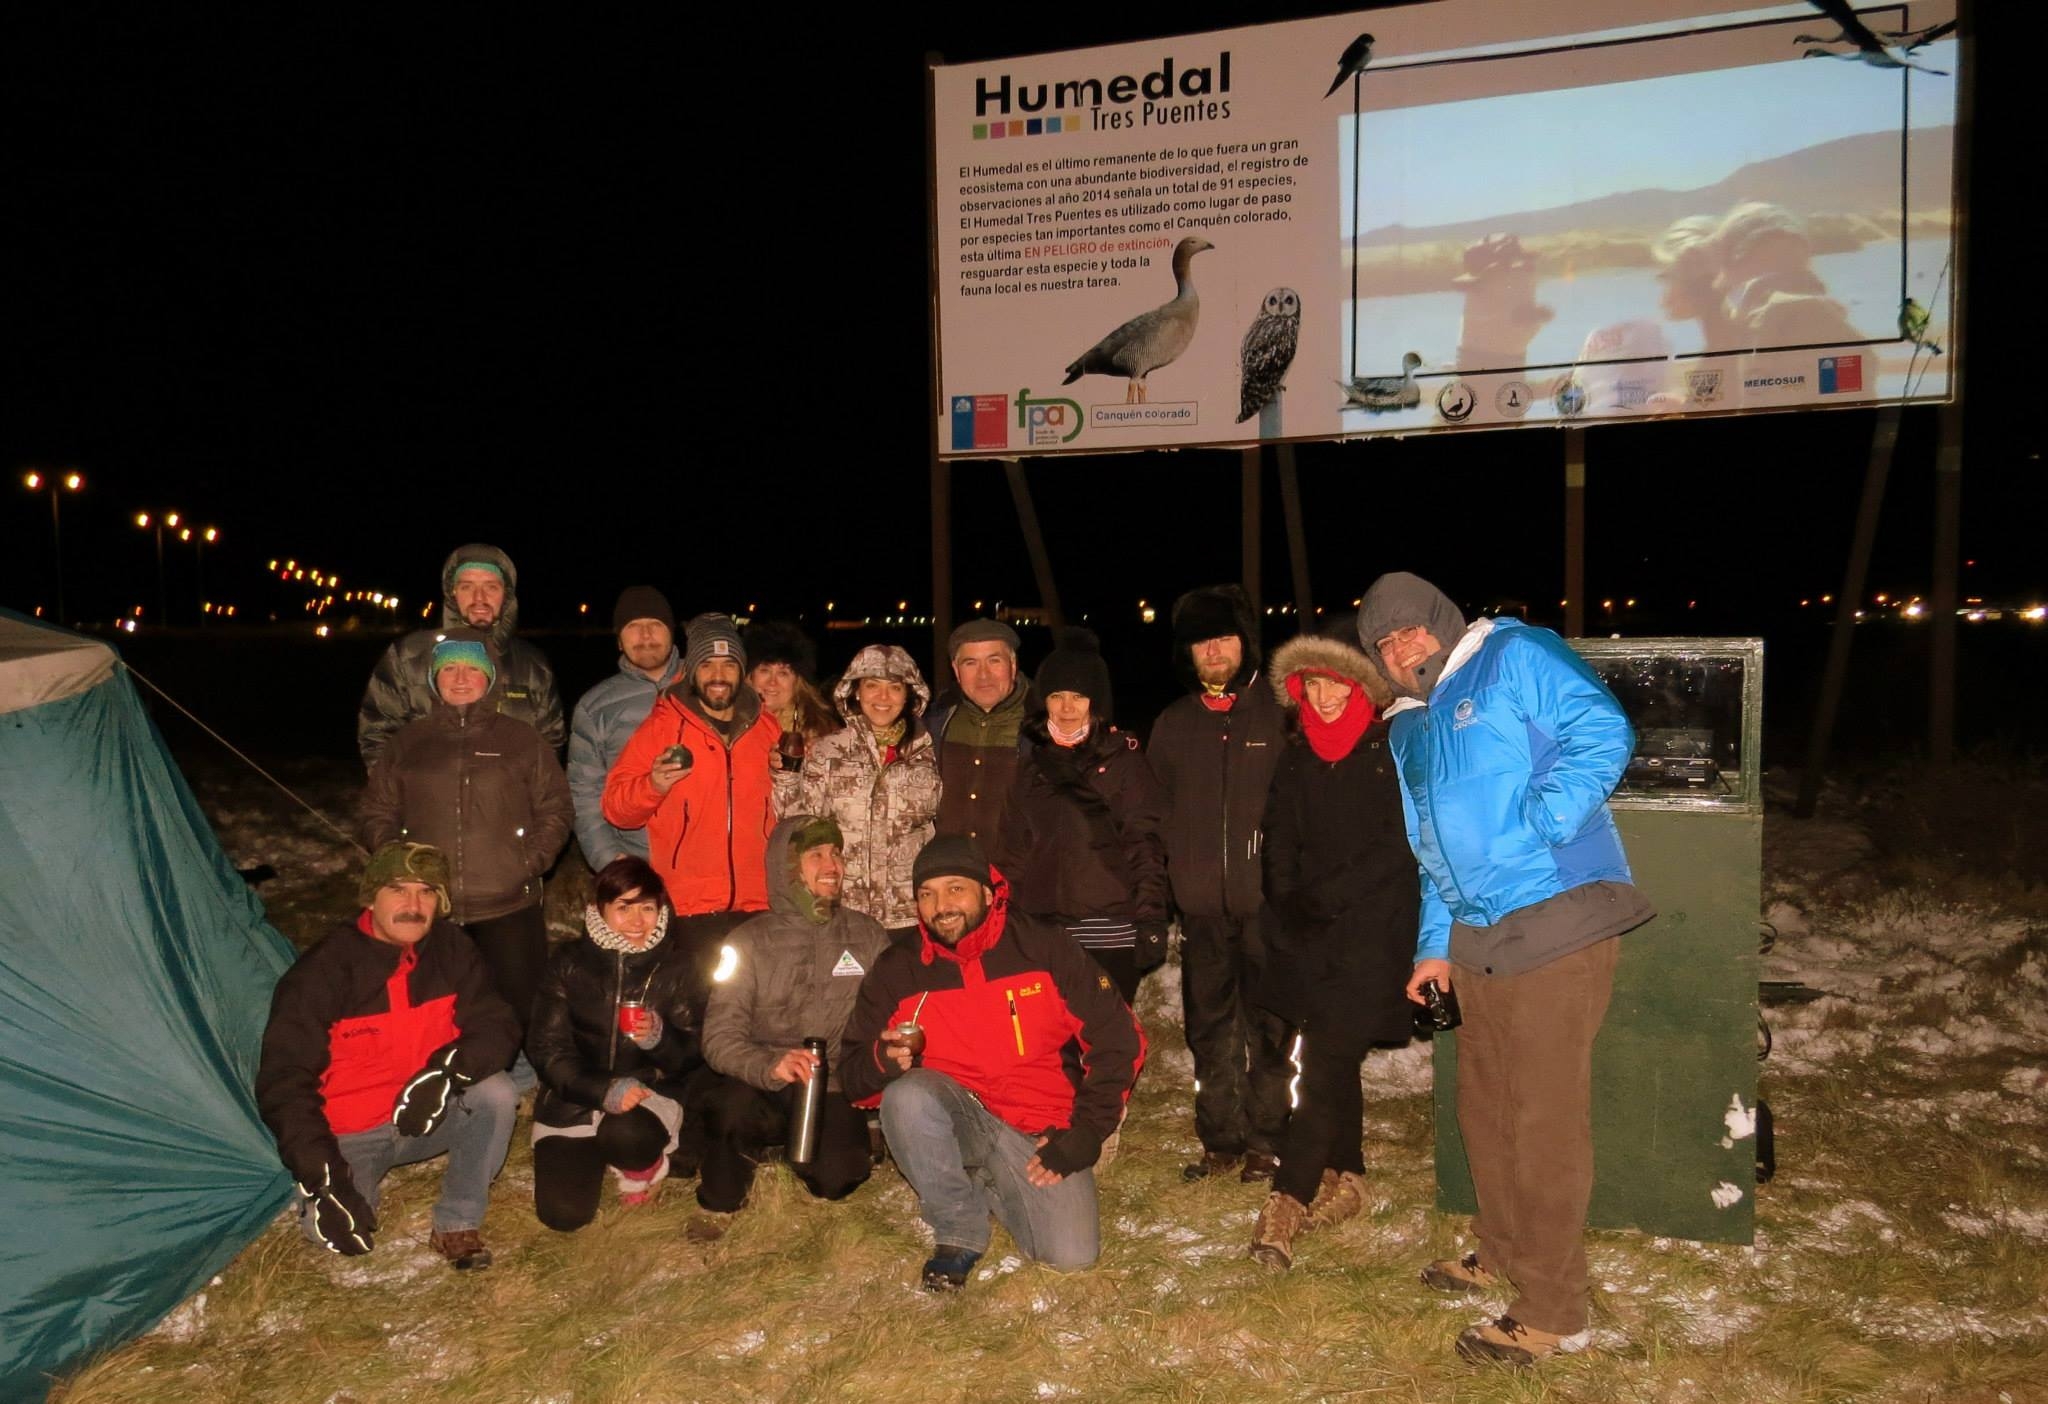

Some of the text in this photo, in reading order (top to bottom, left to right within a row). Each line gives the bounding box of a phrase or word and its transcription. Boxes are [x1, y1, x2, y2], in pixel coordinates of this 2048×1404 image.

[975, 52, 1231, 117] Humedal
[1091, 98, 1231, 132] Tres Puentes
[960, 139, 1298, 178] El Humedal es el último remanente de lo que fuera un gran
[960, 155, 1308, 195] ecosistema con una abundante biodiversidad, el registro de
[960, 174, 1296, 212] observaciones al año 2014 señala un total de 91 especies,
[960, 193, 1292, 229] El Humedal Tres Puentes es utilizado como lugar de paso
[960, 208, 1292, 248] por especies tan importantes como el Canquén colorado,
[960, 252, 984, 263] esta
[1024, 247, 1040, 259] EN
[1044, 242, 1098, 257] PELIGRO
[1100, 241, 1114, 252] de
[1118, 236, 1174, 251] extinción,
[960, 256, 1150, 281] resguardar esta especie y toda la
[960, 276, 1121, 296] fauna local es nuestra tarea.
[1744, 376, 1806, 388] MERCOSUR
[1145, 408, 1191, 418] colorado
